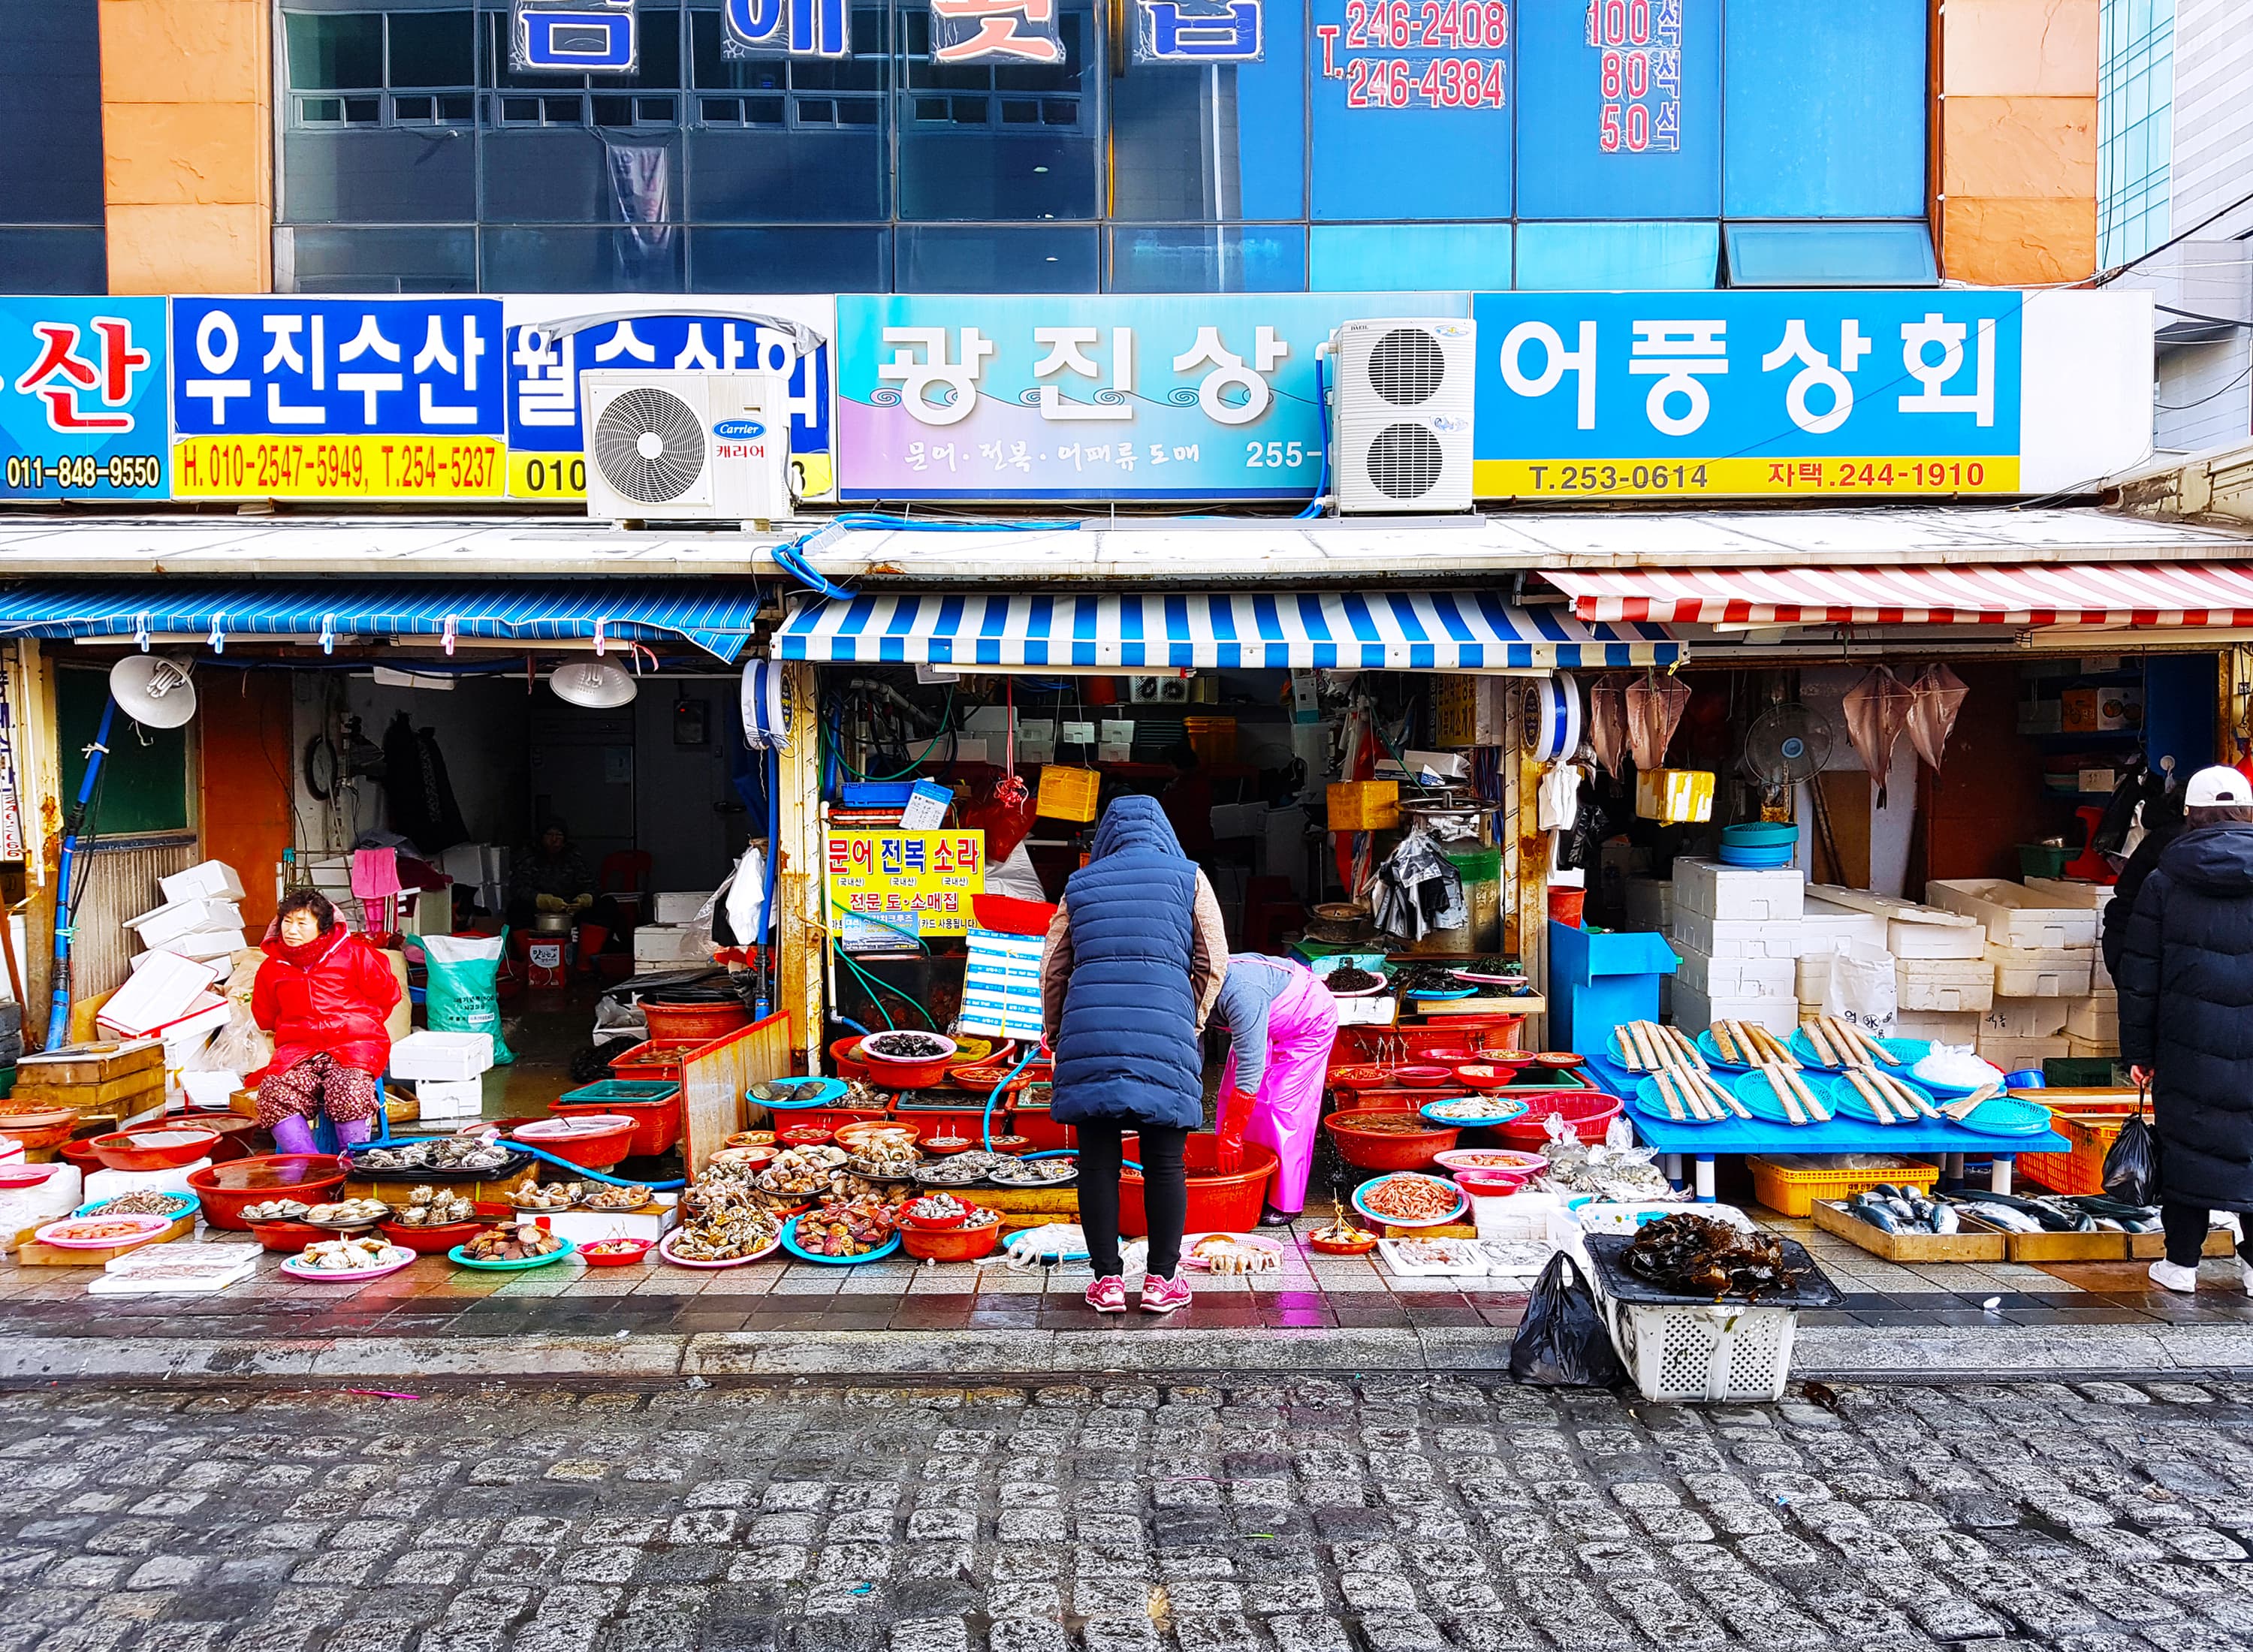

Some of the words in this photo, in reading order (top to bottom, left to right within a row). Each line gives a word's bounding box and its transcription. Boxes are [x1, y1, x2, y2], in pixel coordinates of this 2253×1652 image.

[1347, 0, 1507, 48] 246-2408
[1347, 59, 1504, 108] 246-4384
[185, 309, 484, 425] 우진수산
[1499, 312, 1995, 436] 어풍상회
[719, 424, 759, 434] Carrier
[716, 445, 765, 458] 캐리어
[6, 455, 161, 488] 011-848-9550
[1529, 466, 1709, 490] T.253-0614
[828, 839, 873, 874] 문어
[881, 839, 925, 874] 전복
[933, 838, 979, 874] 소라
[849, 893, 882, 912] 전문
